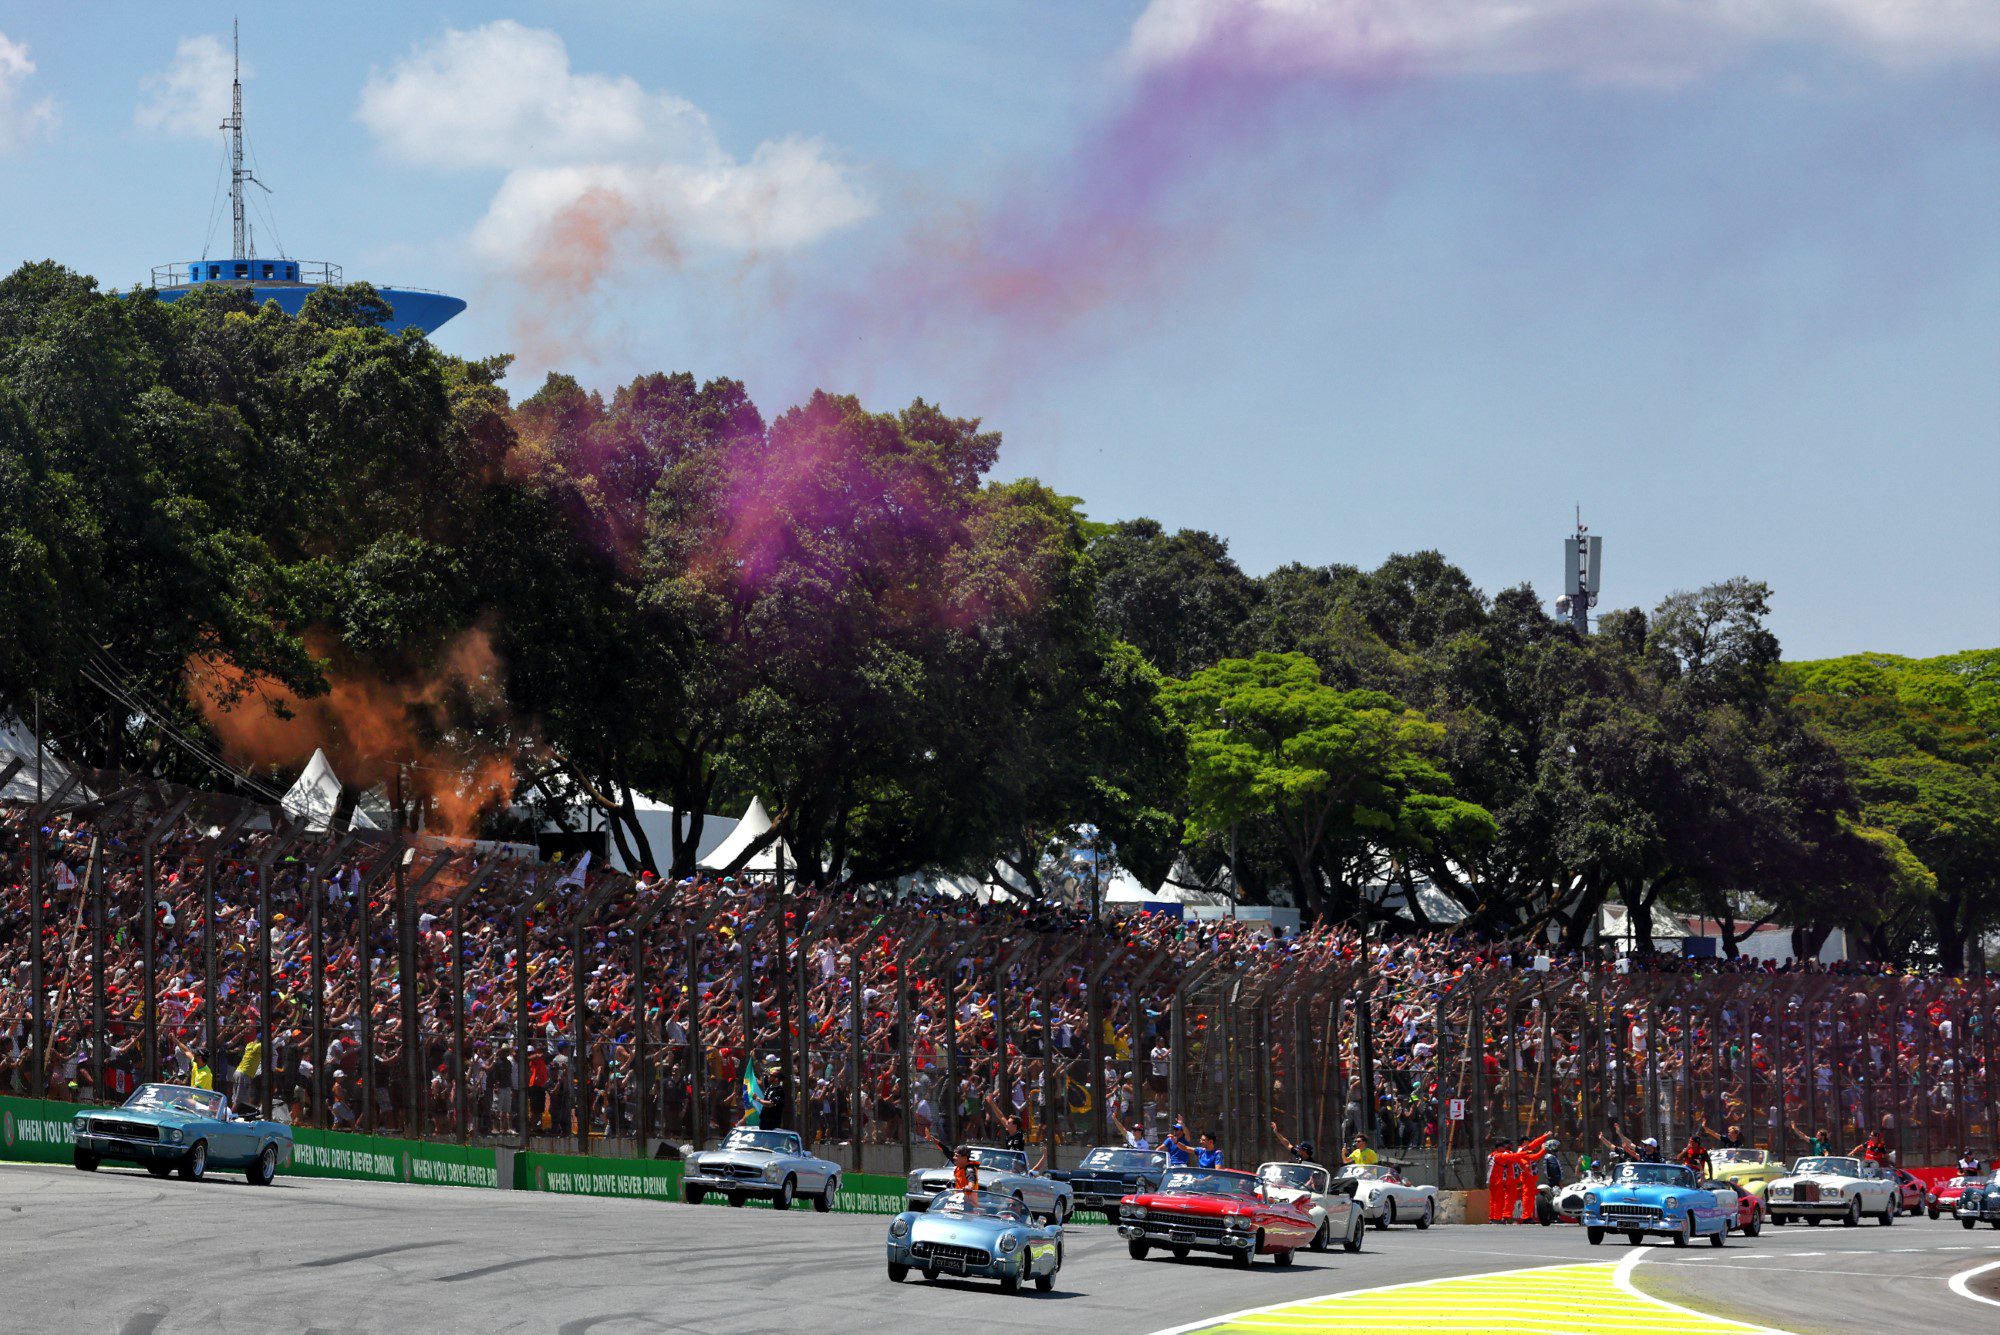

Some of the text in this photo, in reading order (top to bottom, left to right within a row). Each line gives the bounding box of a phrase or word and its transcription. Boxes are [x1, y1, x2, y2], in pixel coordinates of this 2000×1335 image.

[17, 1119, 42, 1141] WHEN
[43, 1121, 61, 1143] YOU
[729, 1132, 755, 1142] 44
[294, 1143, 395, 1177] WHEN YOU DRIVE NEVER DRINK
[1091, 1151, 1114, 1161] 22
[413, 1158, 432, 1179] WHEN
[433, 1161, 447, 1182] YOU
[448, 1163, 466, 1183] DRIVE
[467, 1165, 487, 1185] NEVER
[1342, 1167, 1364, 1178] 10
[1622, 1165, 1635, 1177] 6
[548, 1172, 668, 1196] WHEN YOU DRIVE NEVER DRINK
[1171, 1173, 1194, 1183] 31
[841, 1192, 855, 1211] YOU
[857, 1193, 877, 1212] DRIVE
[878, 1195, 901, 1213] NEVER
[948, 1192, 965, 1203] 4
